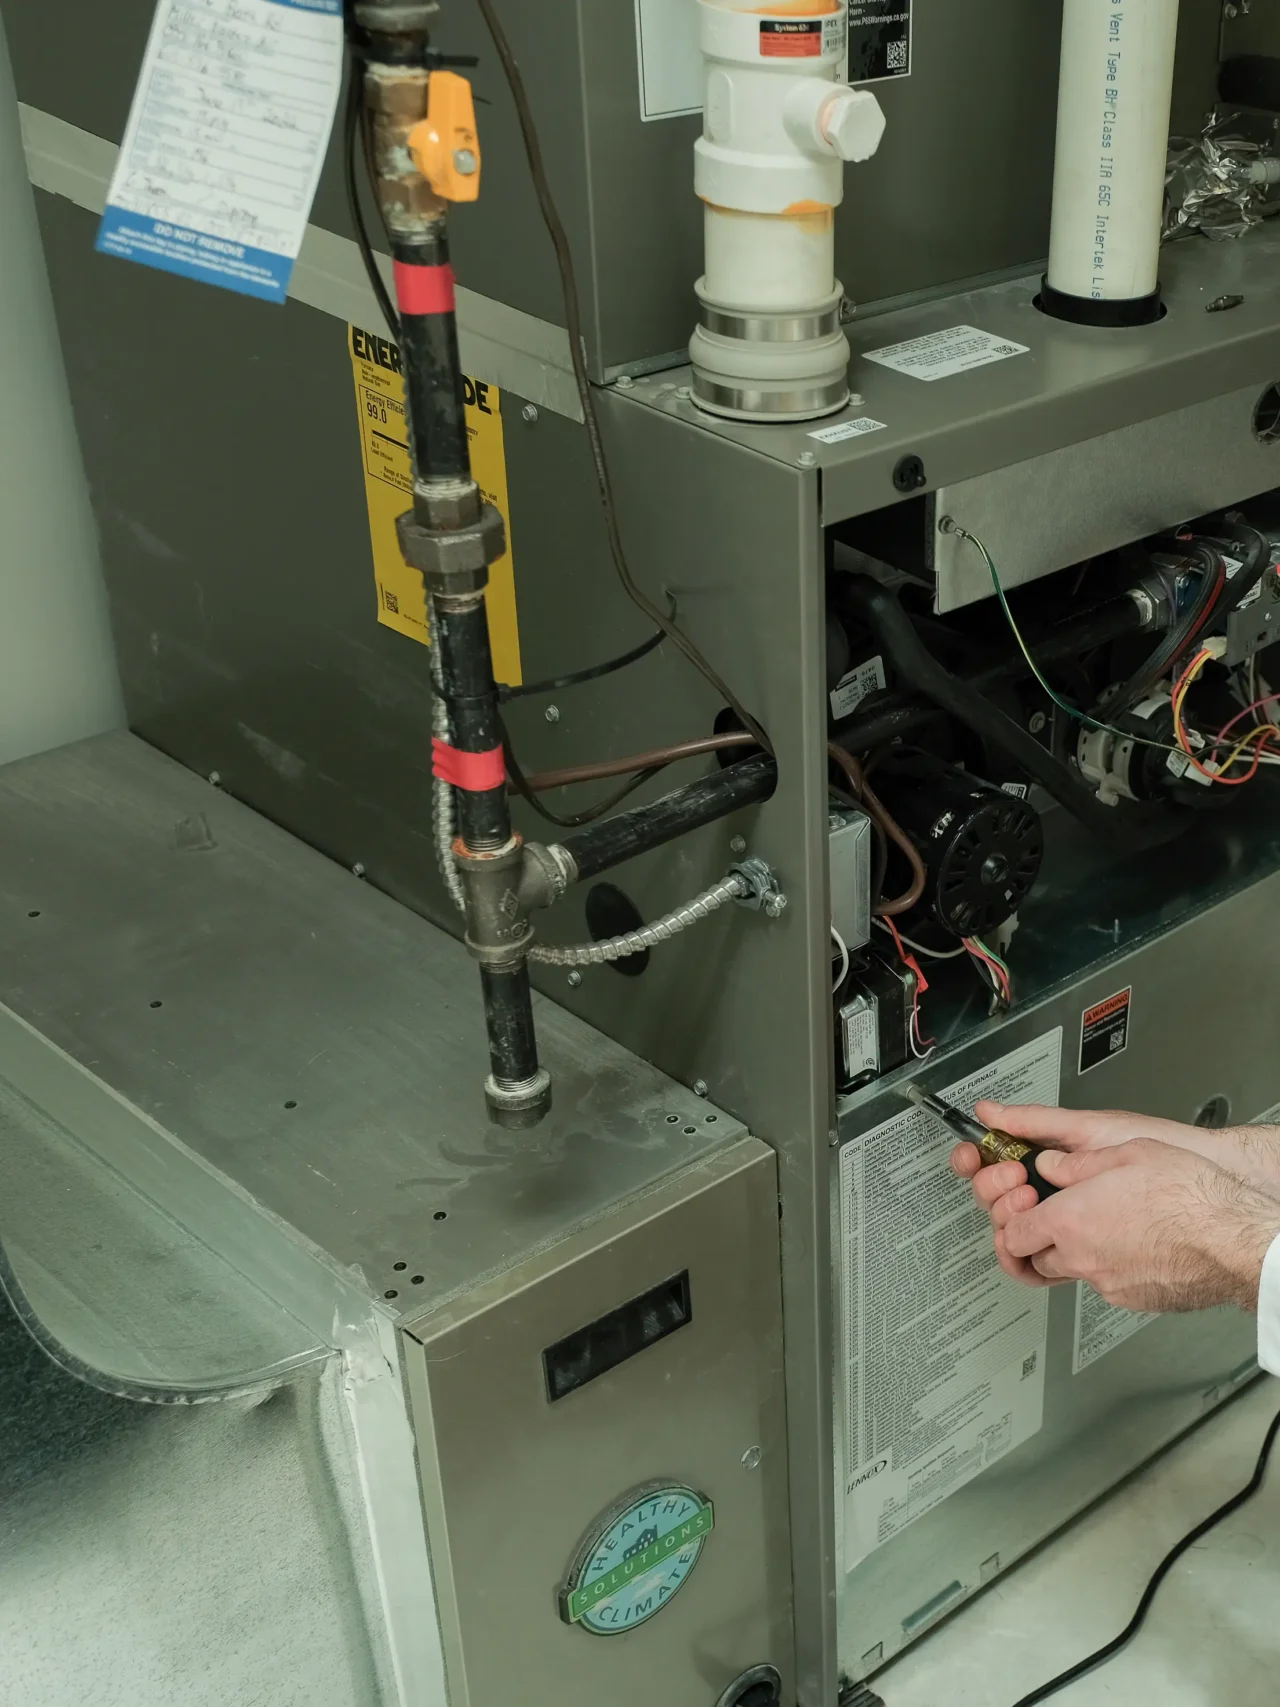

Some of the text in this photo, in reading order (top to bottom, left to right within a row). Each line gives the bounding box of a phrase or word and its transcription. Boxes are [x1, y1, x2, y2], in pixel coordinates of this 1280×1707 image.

[1109, 13, 1123, 42] Vent
[1106, 51, 1121, 81] Type
[1102, 111, 1116, 149] Class
[1098, 185, 1111, 207] 65C
[174, 228, 197, 244] NOT
[1093, 215, 1109, 270] Intertek
[366, 390, 386, 409] Energy
[367, 402, 387, 424] 99.0
[1093, 993, 1128, 1018] WARNING
[864, 1116, 907, 1147] DIAGNOSTIC
[941, 1090, 957, 1102] TUS
[956, 1084, 967, 1098] OF
[967, 1068, 998, 1093] FURNACE
[844, 1144, 862, 1159] CODE
[846, 1462, 883, 1495] LENNOX
[592, 1500, 691, 1571] HEALTHY
[580, 1516, 704, 1605] SOLUTIONS
[599, 1552, 693, 1623] CLIMATE
